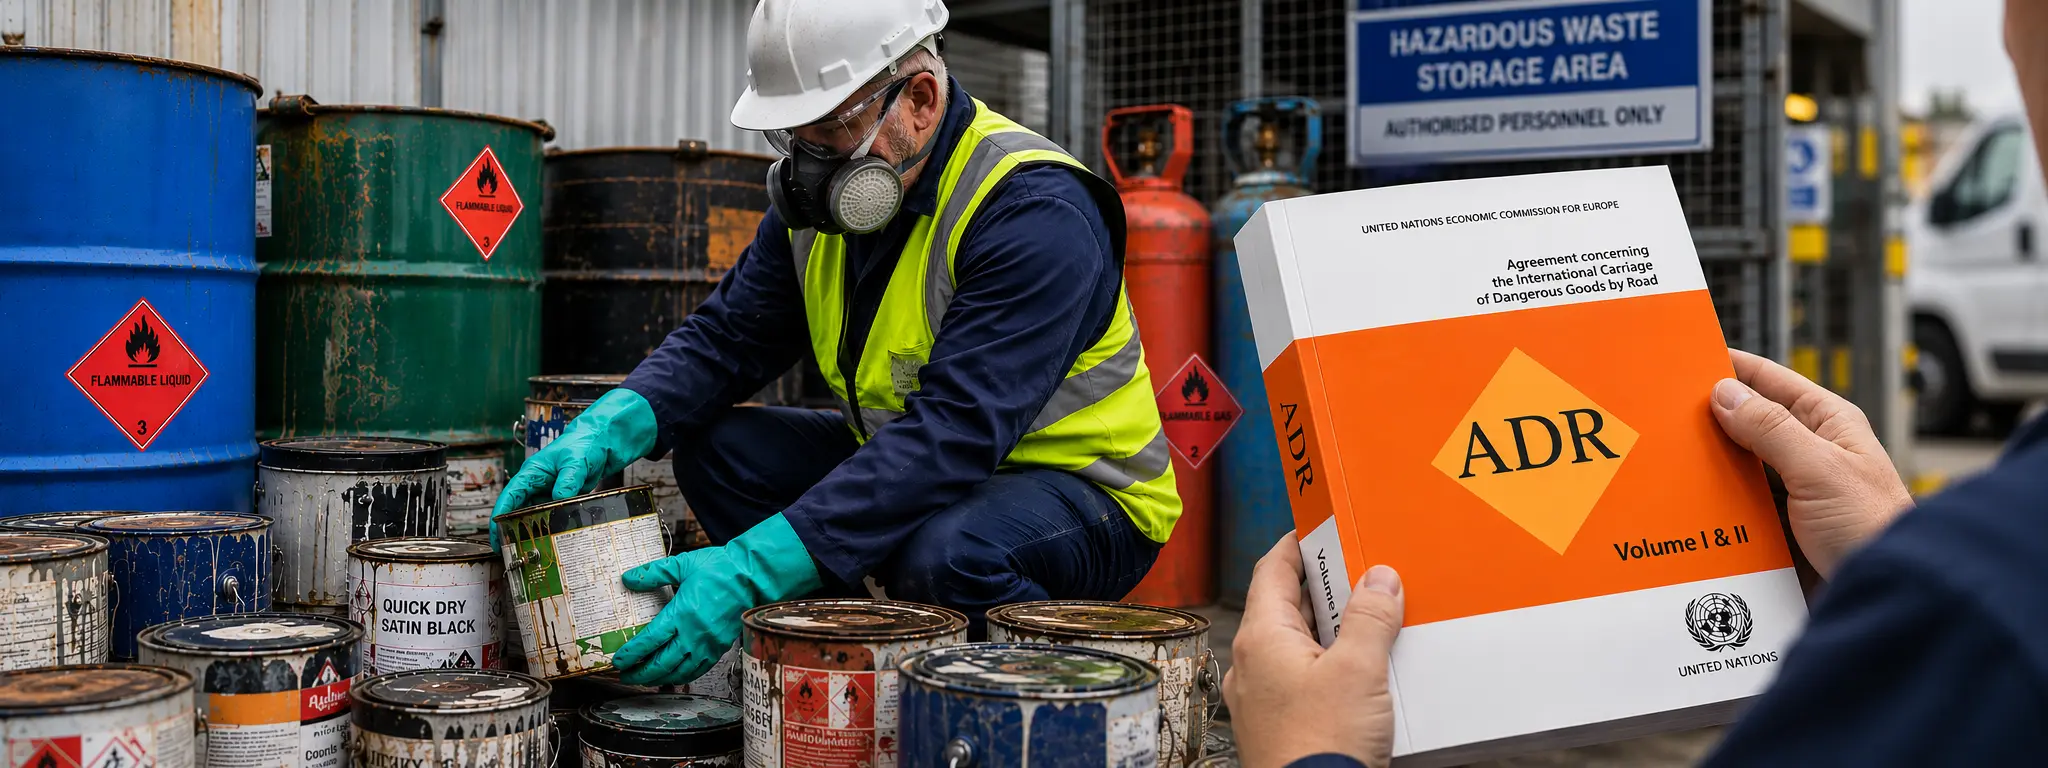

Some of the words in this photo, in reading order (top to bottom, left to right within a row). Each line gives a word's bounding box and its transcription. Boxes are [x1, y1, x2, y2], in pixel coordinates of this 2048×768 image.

[1390, 19, 1554, 56] HAZARDOUS
[1562, 11, 1659, 45] WASTE
[1417, 56, 1544, 92] STORAGE
[1551, 52, 1628, 82] AREA
[1384, 113, 1494, 138] AUTHORISED
[1500, 108, 1610, 132] PERSONNEL
[1615, 104, 1665, 126] ONLY
[456, 201, 495, 212] FLAMMABLE
[496, 204, 513, 213] LIQUID
[1362, 223, 1398, 234] UNITED
[1401, 217, 1444, 229] NATIONS
[1447, 212, 1497, 224] ECONOMIC
[1500, 206, 1560, 219] COMMISSION
[1562, 204, 1581, 214] FOR
[1583, 200, 1620, 212] EUROPE
[483, 236, 490, 248] 3
[1507, 253, 1578, 271] Agreement
[1581, 246, 1649, 264] concerning
[1492, 277, 1513, 288] the
[1517, 266, 1597, 285] International
[1601, 260, 1653, 276] Carriage
[1476, 293, 1489, 305] of
[1493, 288, 1562, 304] Dangerous
[1566, 281, 1606, 296] Goods
[1608, 278, 1624, 292] by
[1628, 274, 1659, 287] Road
[91, 375, 156, 386] FLAMMABLE
[160, 374, 191, 387] LIQUID
[137, 420, 147, 435] 3
[1213, 411, 1232, 421] GAS
[1191, 446, 1198, 458] 2
[1280, 402, 1313, 496] ADR
[1458, 407, 1621, 479] ADR
[1613, 533, 1697, 561] Volume
[1700, 530, 1709, 549] I
[1714, 527, 1731, 547] &
[1733, 524, 1750, 544] II
[1317, 548, 1335, 611] Volume
[383, 598, 430, 615] QUICK
[436, 600, 466, 615] DRY
[382, 618, 421, 635] SATIN
[427, 619, 475, 635] BLACK
[1678, 660, 1722, 677] UNITED
[1725, 651, 1778, 669] NATIONS
